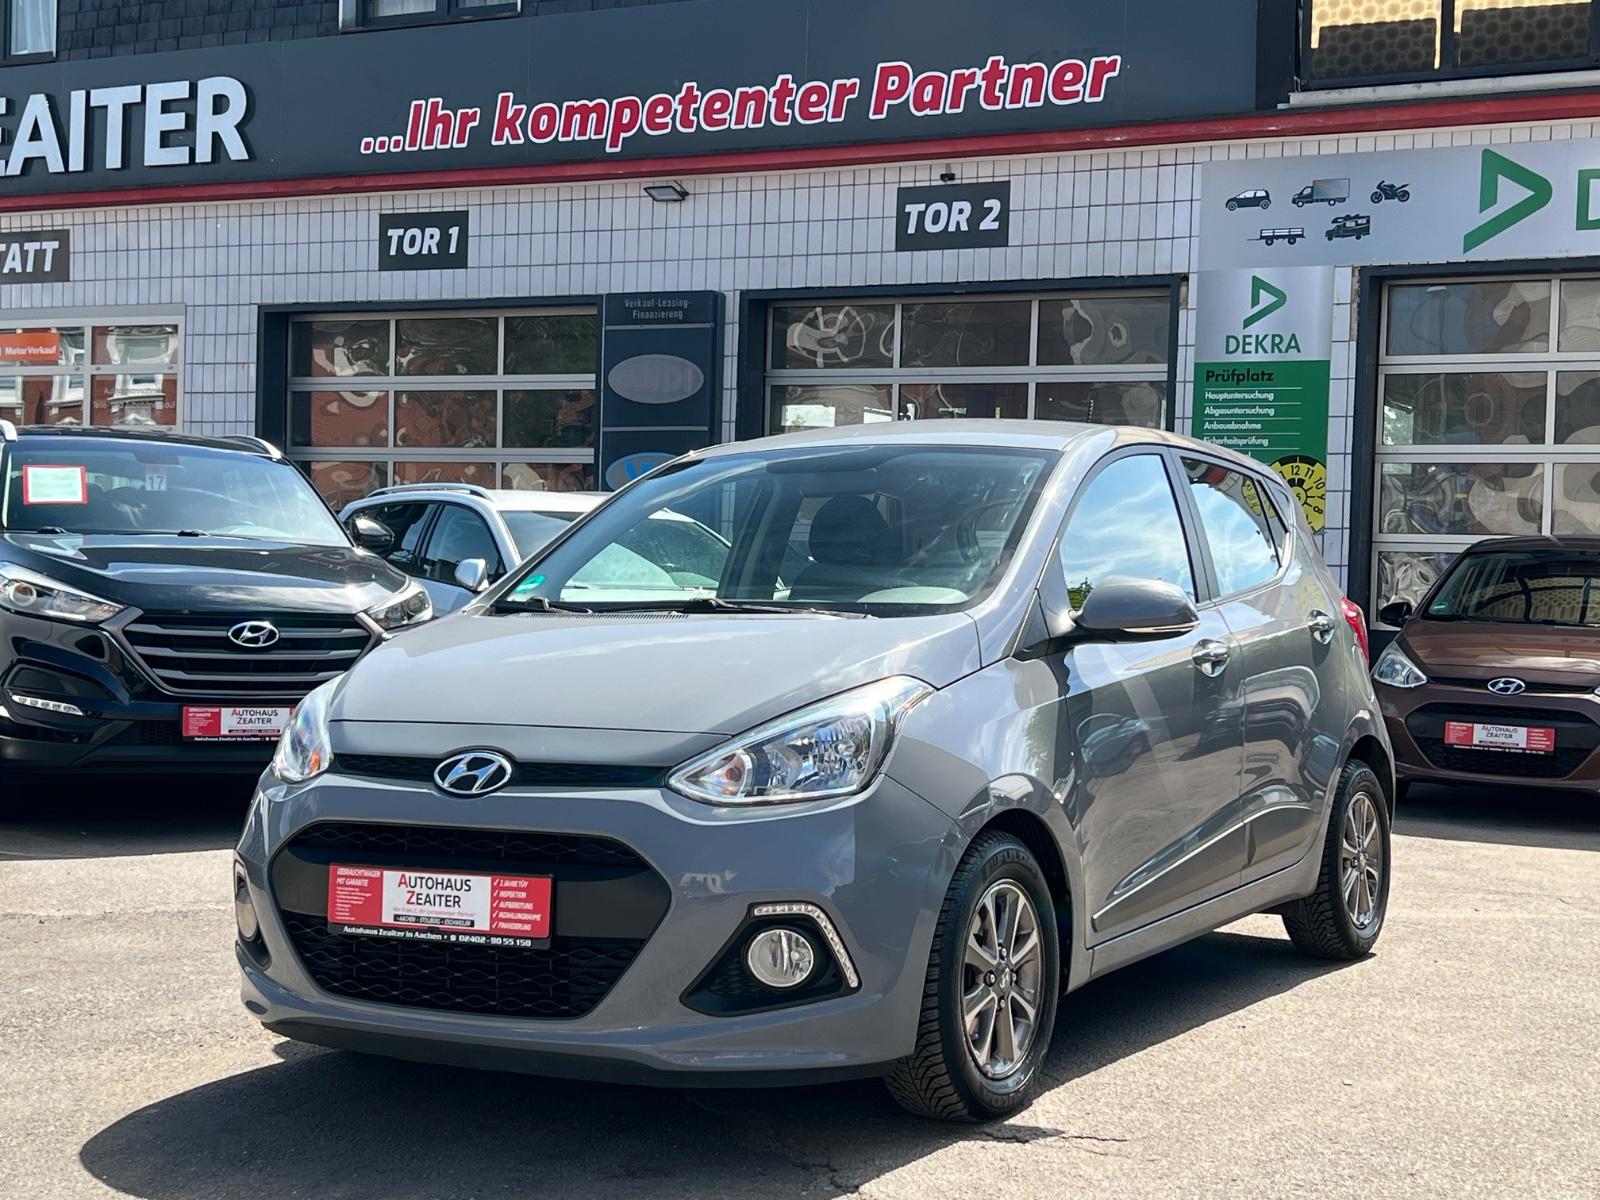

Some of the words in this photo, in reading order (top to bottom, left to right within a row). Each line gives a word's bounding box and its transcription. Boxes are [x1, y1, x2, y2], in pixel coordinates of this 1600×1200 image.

[490, 75, 859, 153] kompetenter
[869, 54, 1121, 121] Partner
[0, 76, 250, 177] AITER
[904, 201, 970, 235] TOR
[980, 198, 1002, 232] 2
[387, 227, 441, 257] TOR
[446, 226, 460, 254] 1
[632, 309, 683, 321] Finanzierung
[1225, 333, 1302, 355] DEKRA
[1205, 368, 1274, 386] Prüfplatz
[1205, 390, 1275, 402] Hauptuntersuchung
[1204, 405, 1275, 417] Abgasuntersuchung
[1204, 421, 1262, 430] Anbauabnahme
[1291, 465, 1300, 476] 12
[1304, 467, 1315, 479] 11
[148, 476, 165, 489] 17
[1313, 477, 1326, 490] 10
[1312, 505, 1324, 515] 8
[231, 708, 279, 717] AUTOHAUS
[236, 717, 272, 725] ZEAITER
[1481, 725, 1519, 734] AUTOHAUS
[398, 873, 472, 892] AUTOHAUS
[406, 890, 461, 908] ZEAITER
[343, 926, 378, 935] Autohaus
[379, 928, 405, 937] Zeaiter
[405, 930, 413, 938] in
[414, 931, 442, 940] Aachen
